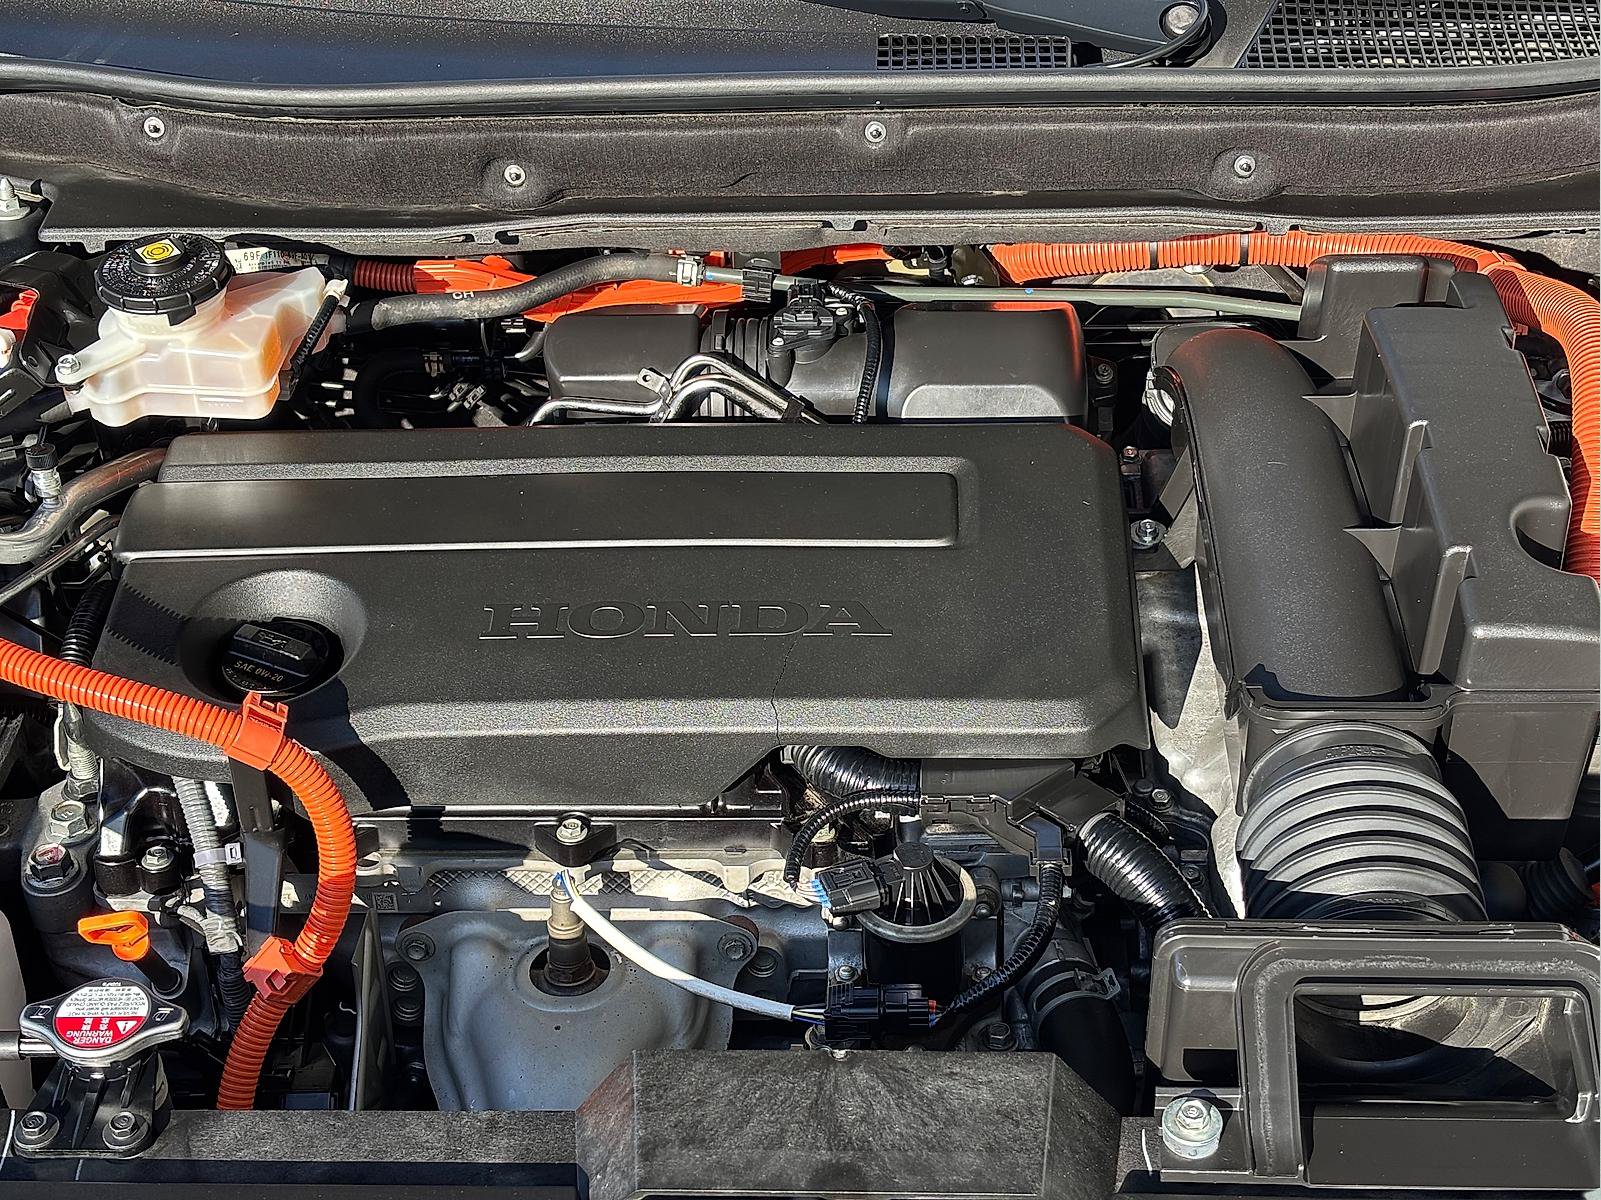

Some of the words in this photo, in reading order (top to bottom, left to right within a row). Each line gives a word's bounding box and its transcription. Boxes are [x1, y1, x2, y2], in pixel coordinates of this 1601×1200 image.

[452, 291, 474, 300] CH
[479, 601, 893, 639] HONDA
[234, 661, 256, 672] SAE
[255, 668, 284, 682] 0W-20
